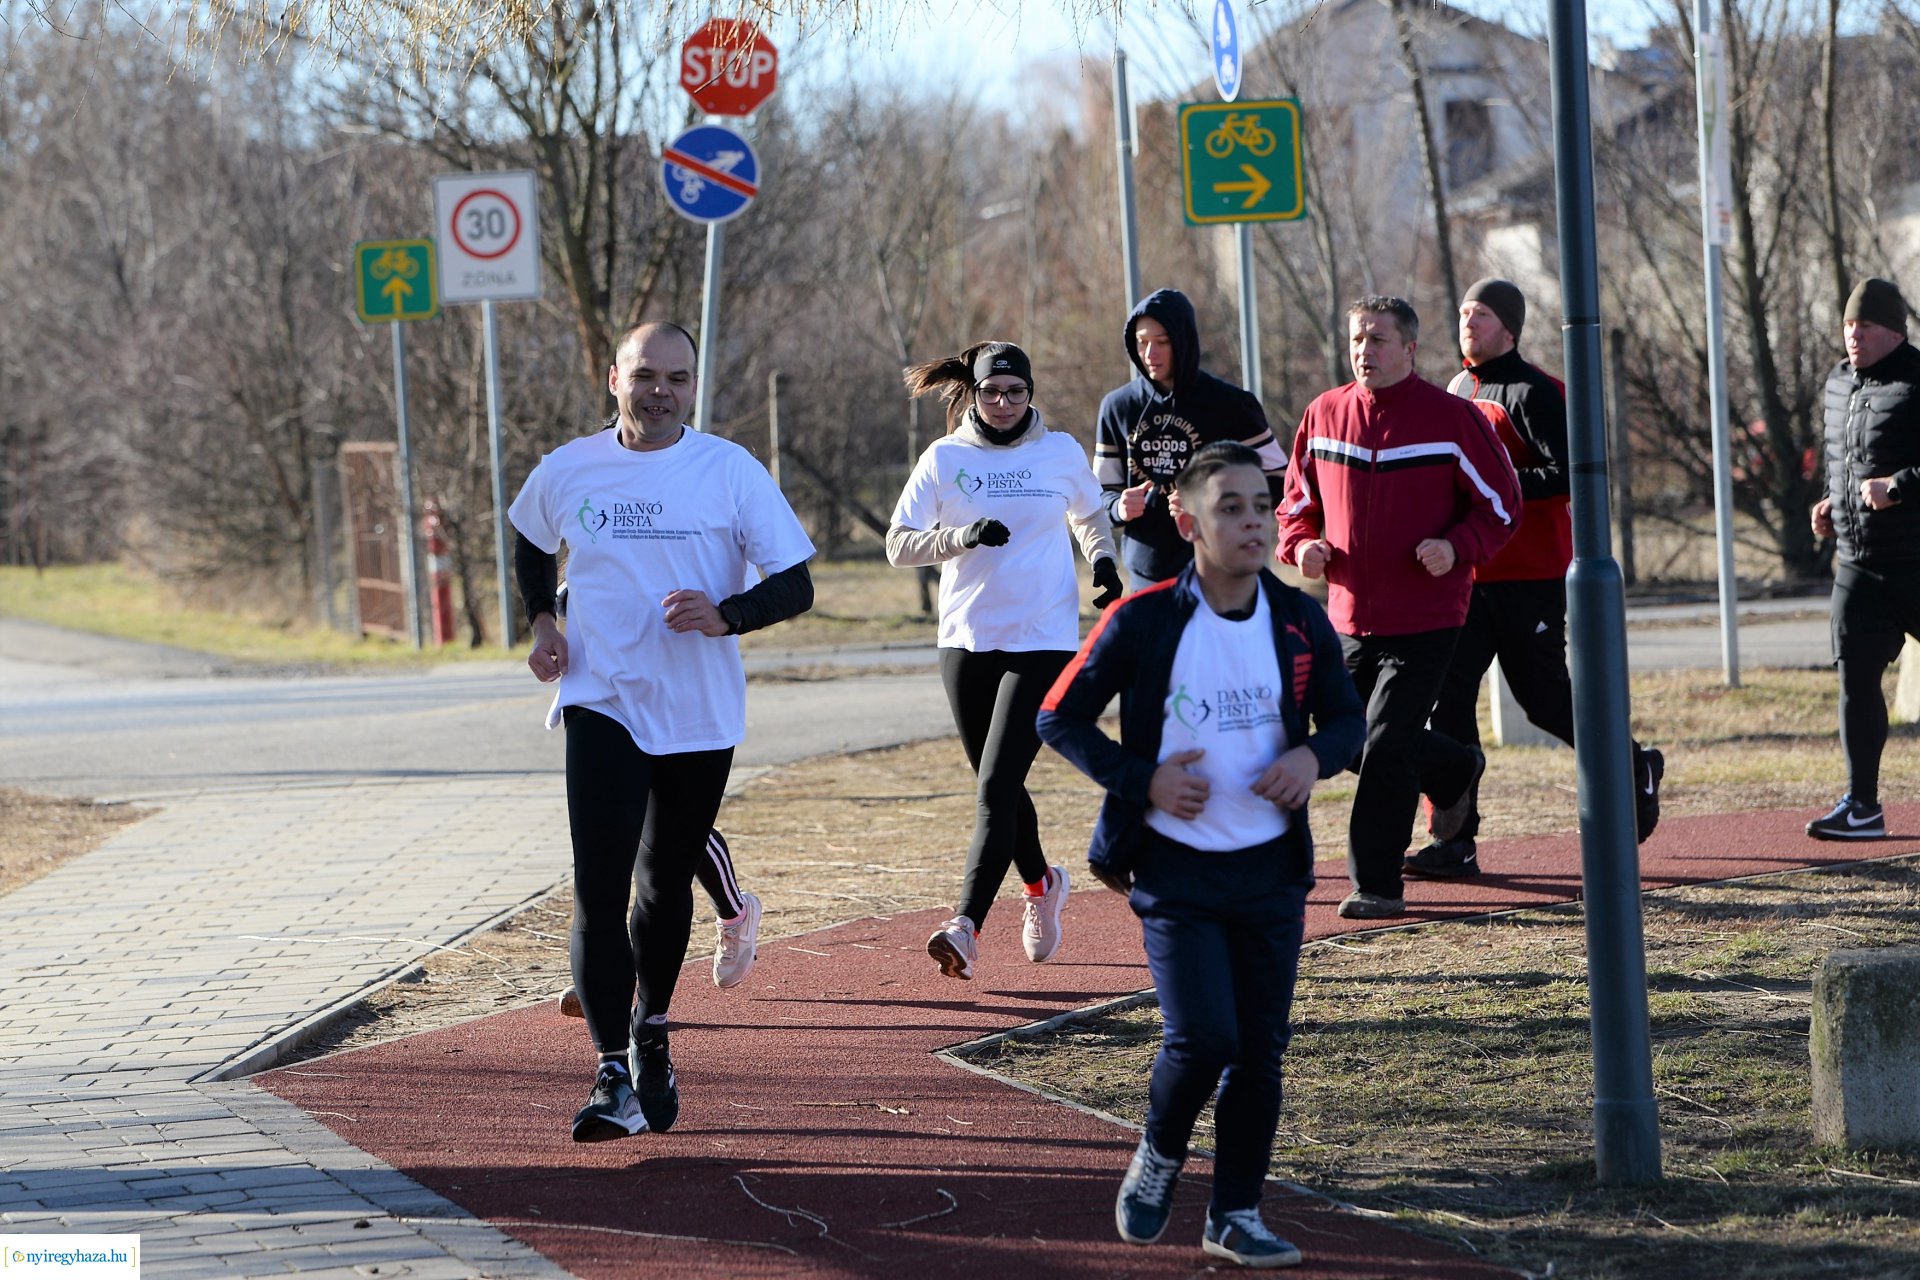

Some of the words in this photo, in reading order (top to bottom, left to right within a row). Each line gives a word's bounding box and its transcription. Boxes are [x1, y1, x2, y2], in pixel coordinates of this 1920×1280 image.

[684, 45, 775, 89] STOP
[466, 207, 506, 241] 30
[1153, 413, 1202, 450] ORIGINAL
[1141, 440, 1187, 452] GOODS
[1142, 457, 1186, 470] SUPPLY
[987, 469, 1032, 480] DANKÓ
[987, 479, 1024, 489] PISTA
[614, 500, 663, 515] DANKÓ
[613, 515, 652, 527] PISTA
